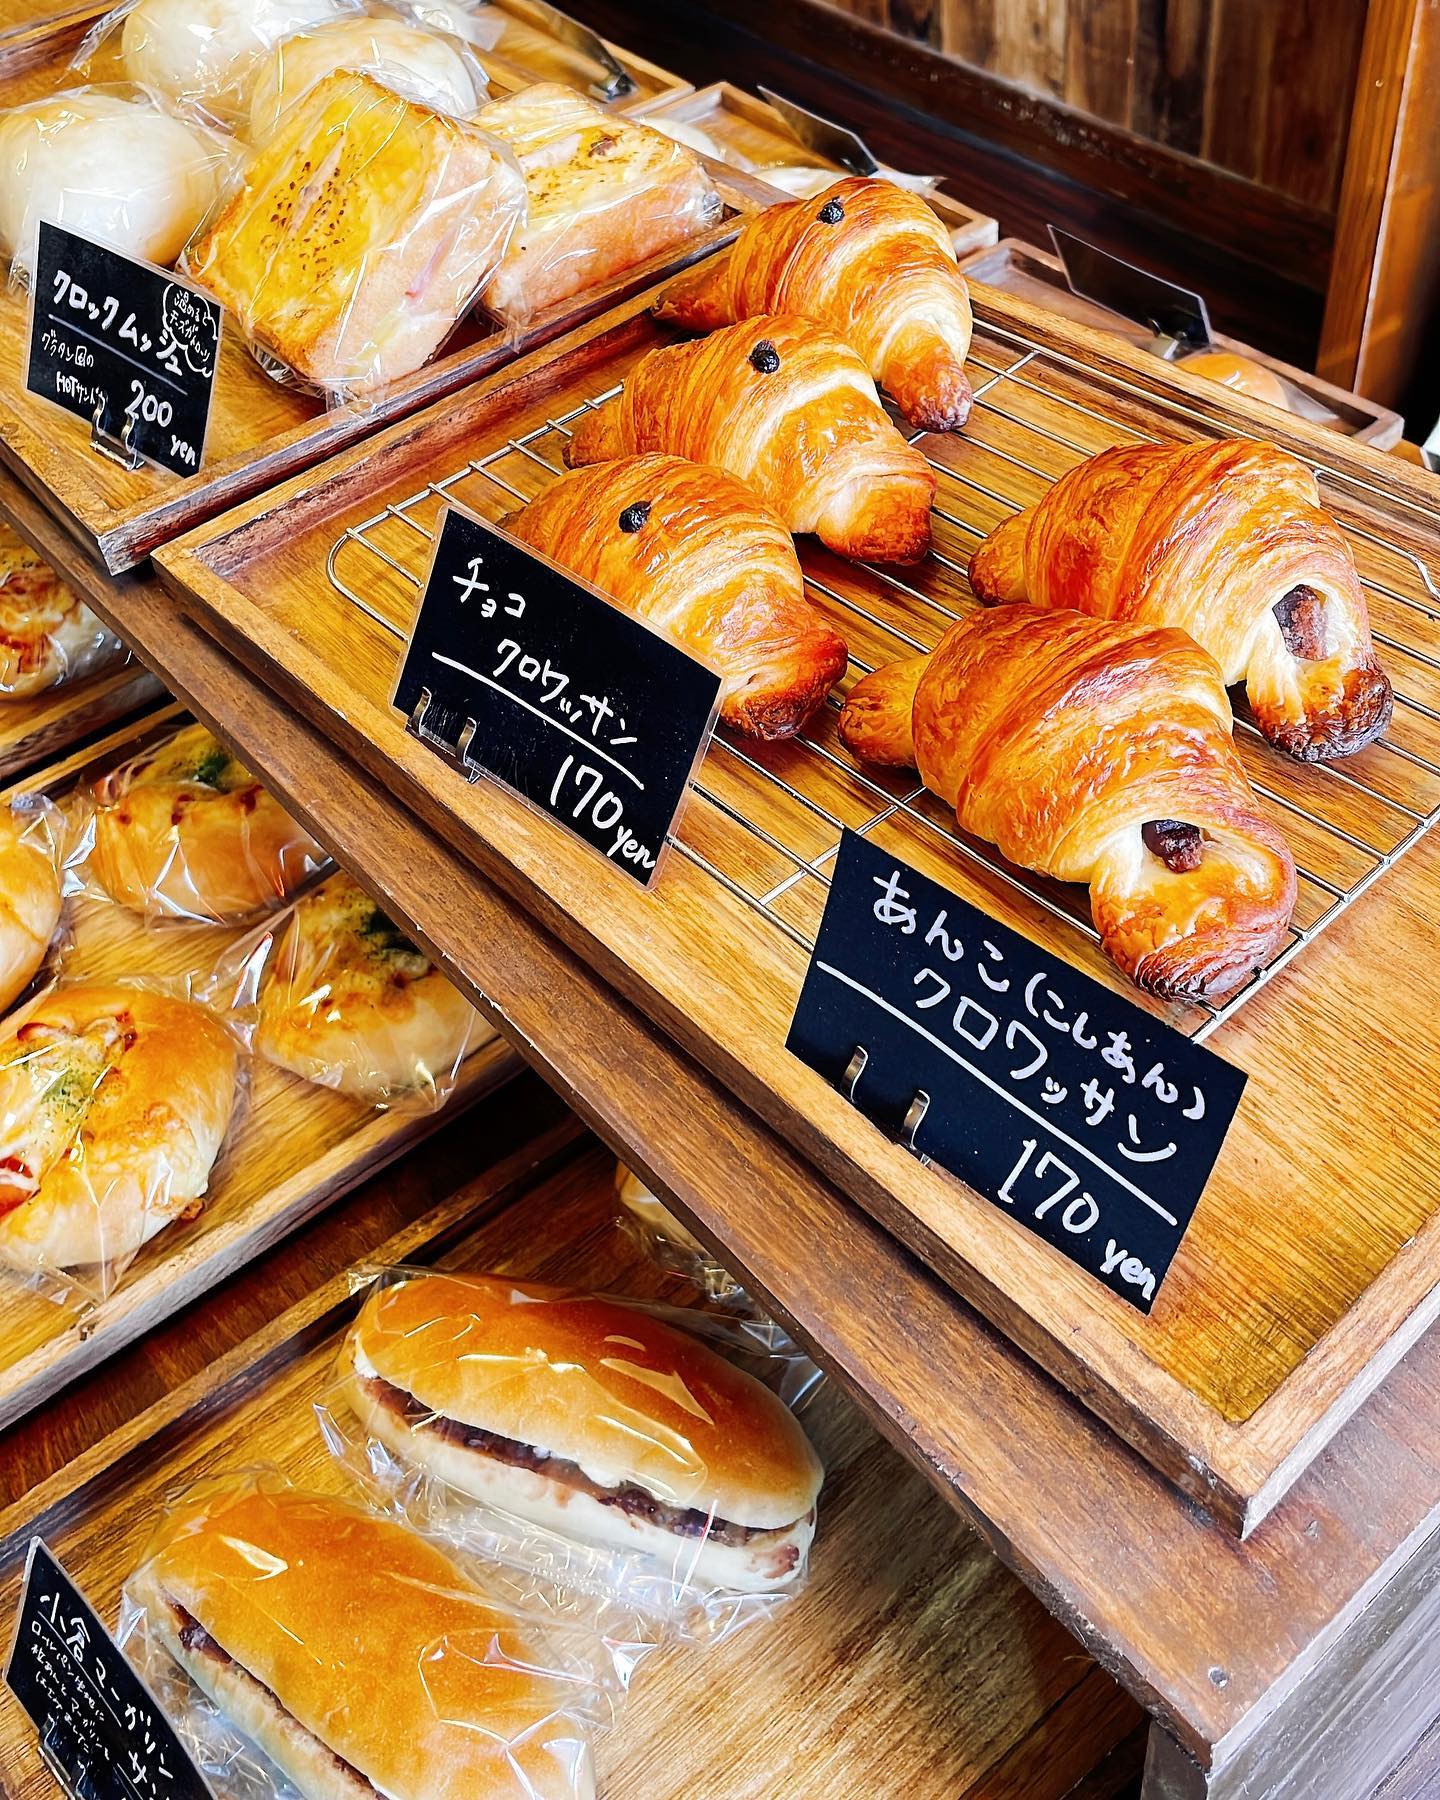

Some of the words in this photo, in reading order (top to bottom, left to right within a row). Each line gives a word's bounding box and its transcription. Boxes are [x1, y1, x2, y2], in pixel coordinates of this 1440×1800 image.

[125, 379, 173, 428] 200
[170, 435, 197, 467] yen
[452, 556, 526, 618] チョコ
[493, 637, 639, 746] クロワッサン
[550, 754, 625, 830] 170
[606, 824, 657, 869] yen
[913, 966, 1178, 1163] クロワッサン
[996, 1138, 1101, 1235] 170
[1100, 1238, 1157, 1302] yen
